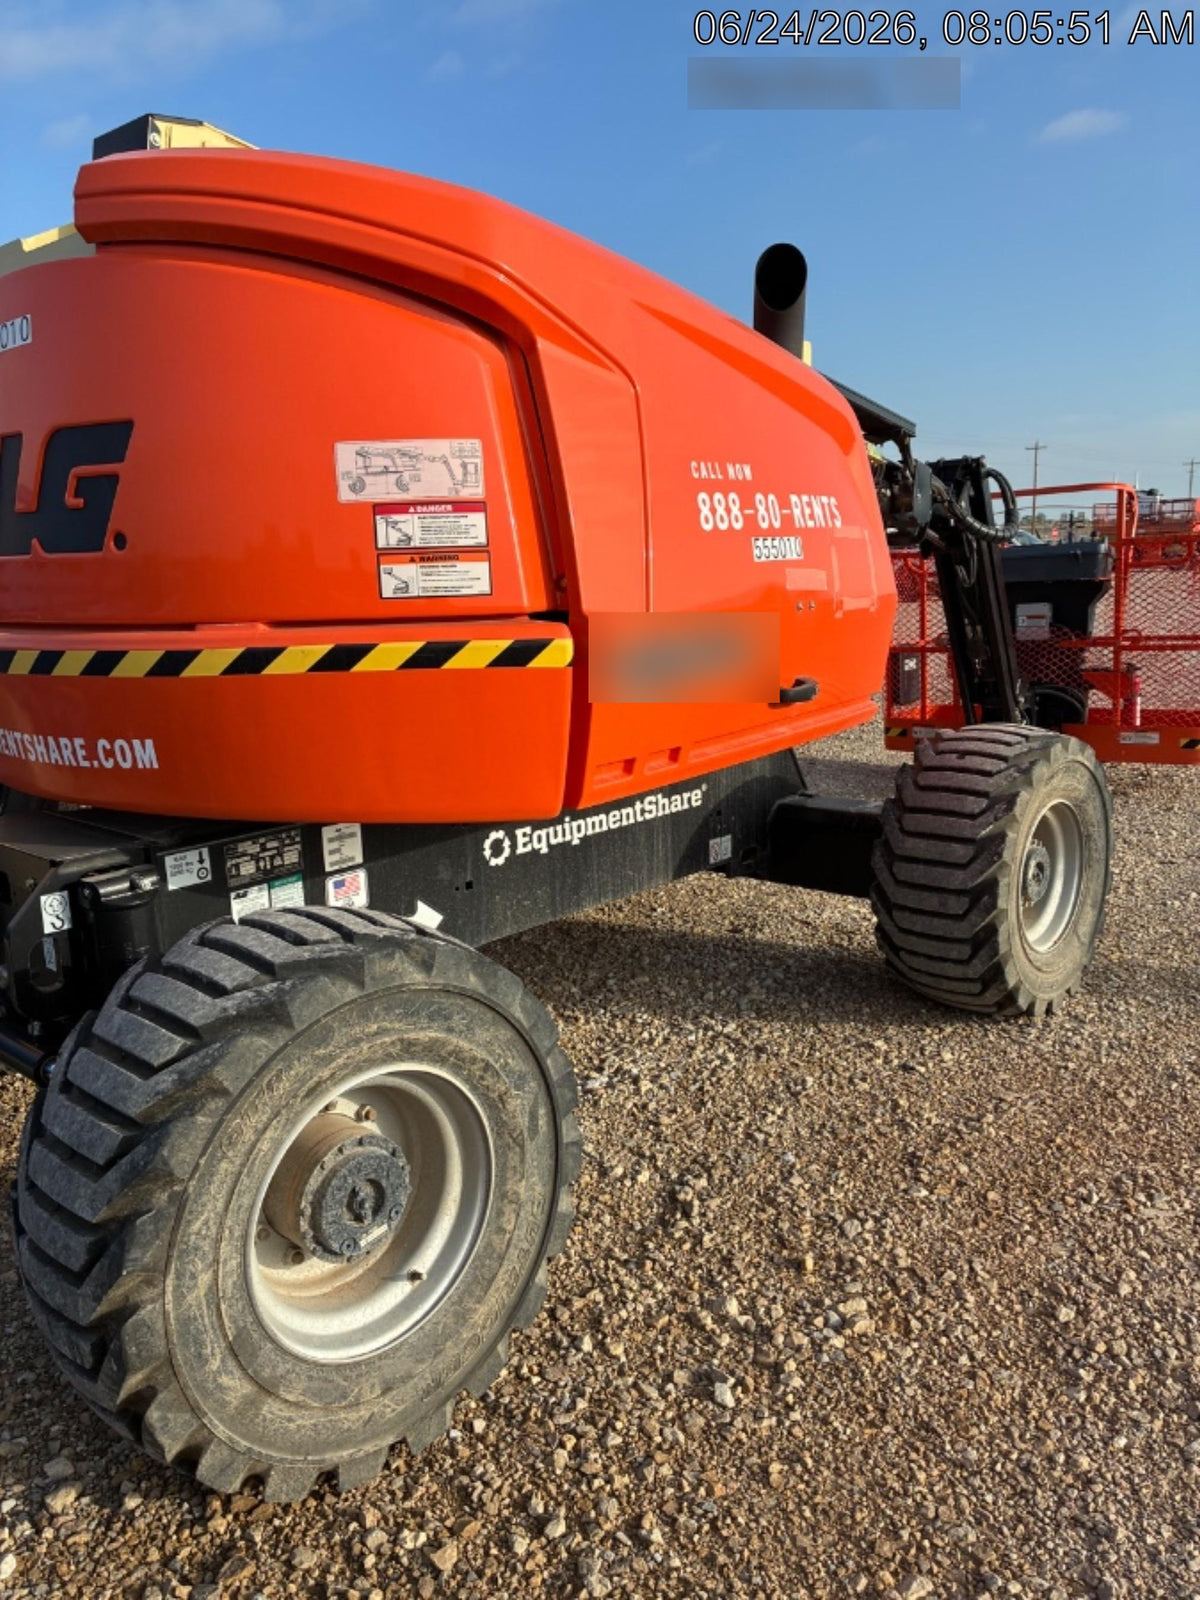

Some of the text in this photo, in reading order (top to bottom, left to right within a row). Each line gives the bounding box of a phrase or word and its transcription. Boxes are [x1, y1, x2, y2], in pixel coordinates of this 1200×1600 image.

[690, 460, 753, 481] CALL NOW
[416, 504, 453, 513] DANGER
[696, 491, 842, 532] 888-80-RENTS
[418, 554, 460, 563] WARNING
[753, 537, 803, 560] 555010
